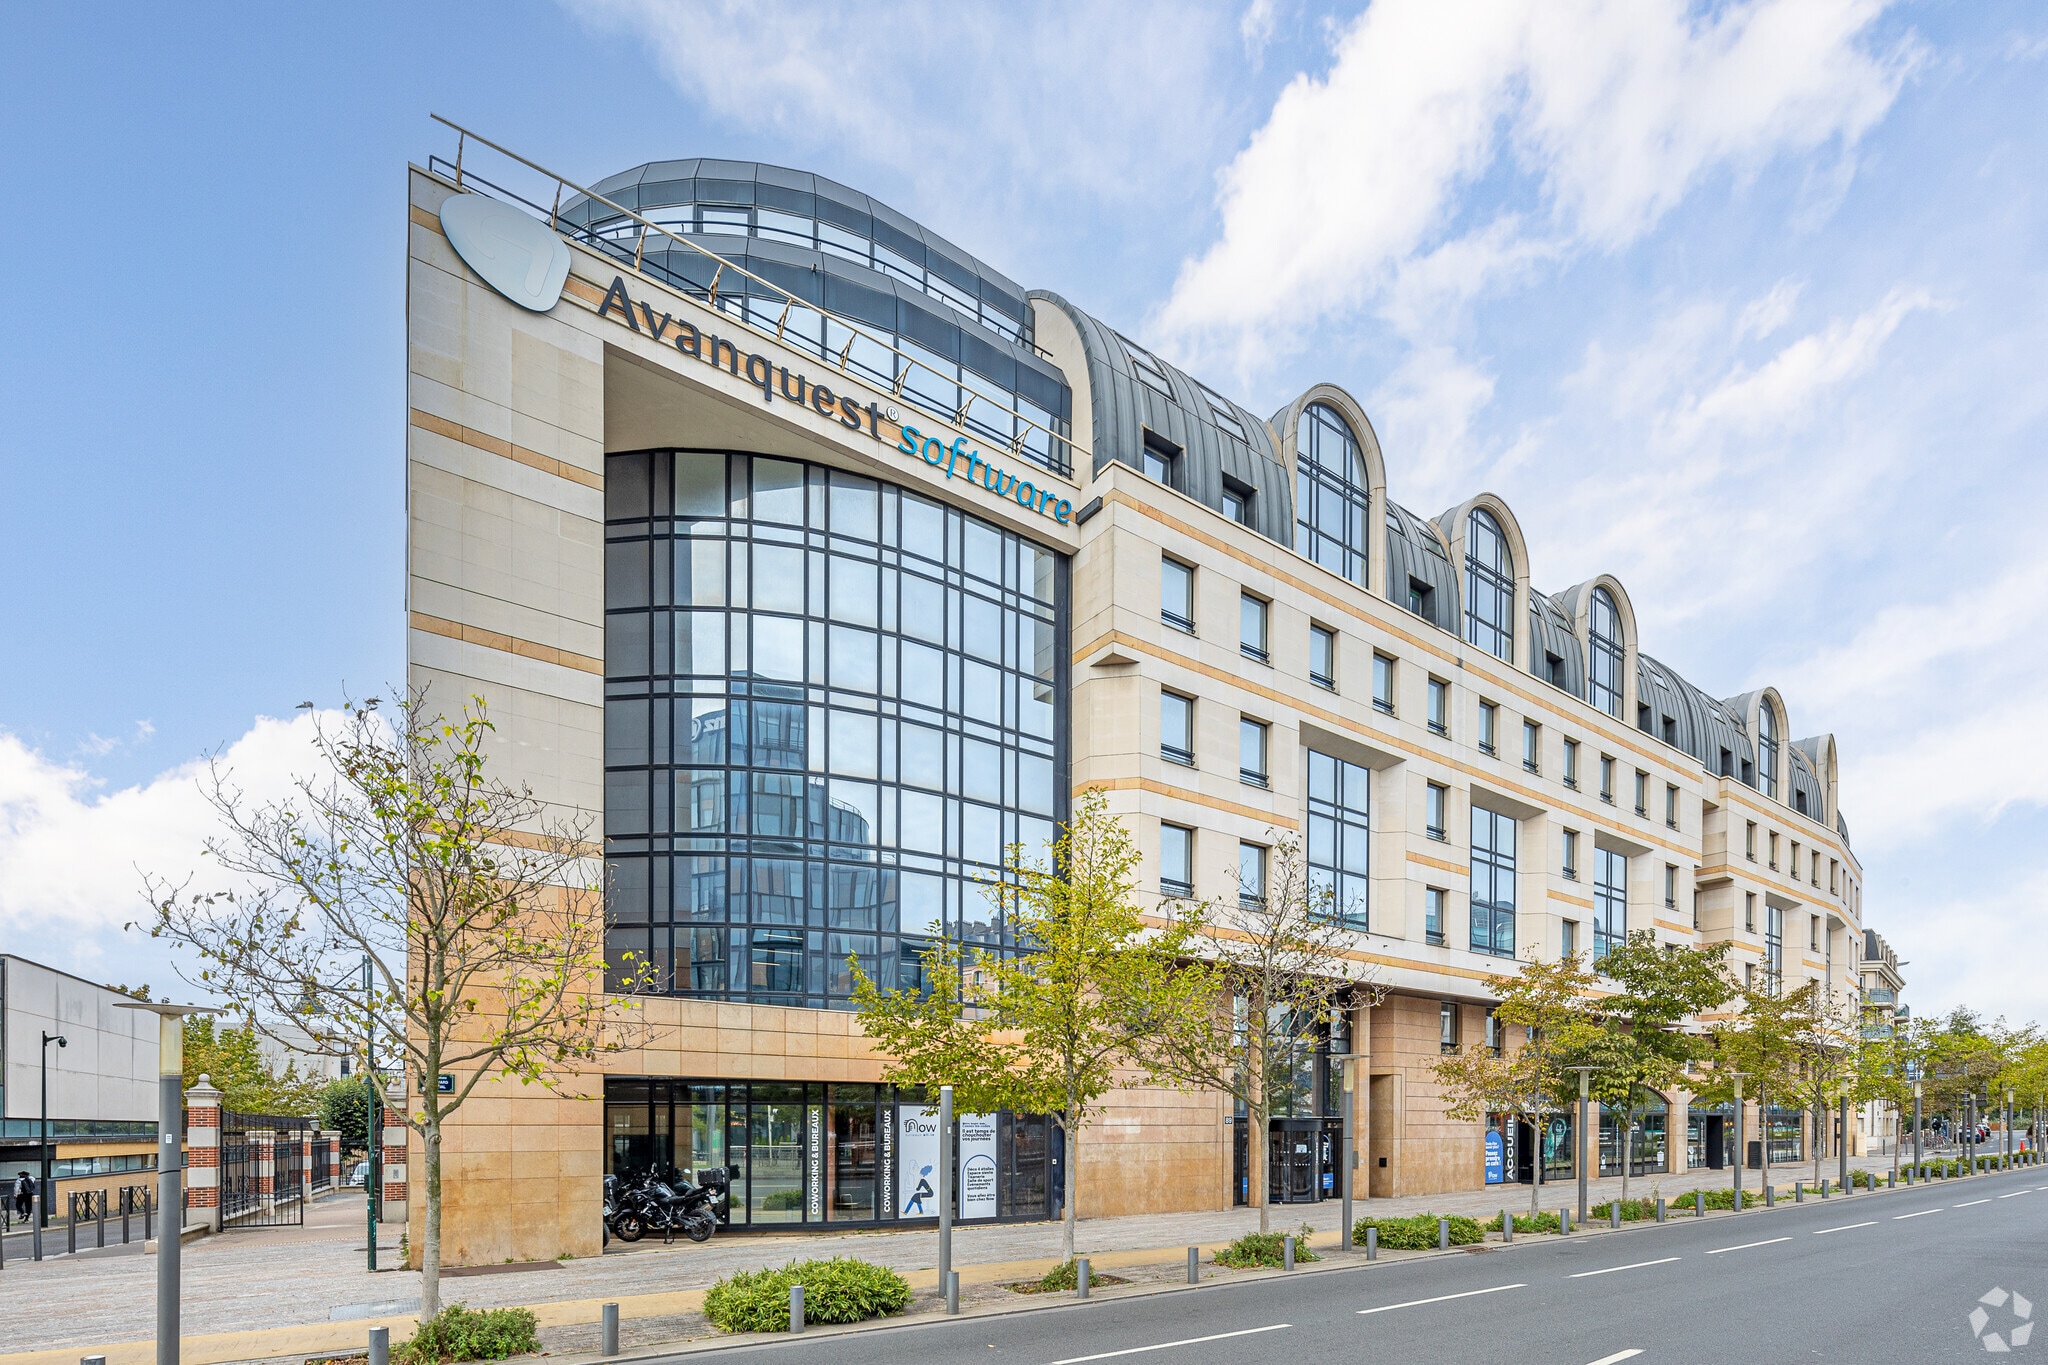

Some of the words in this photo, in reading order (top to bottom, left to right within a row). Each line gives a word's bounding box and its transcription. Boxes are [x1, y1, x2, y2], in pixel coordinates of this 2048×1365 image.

[899, 424, 1073, 526] software
[811, 1109, 819, 1151] BUREAUX
[811, 1159, 819, 1215] COWORKING
